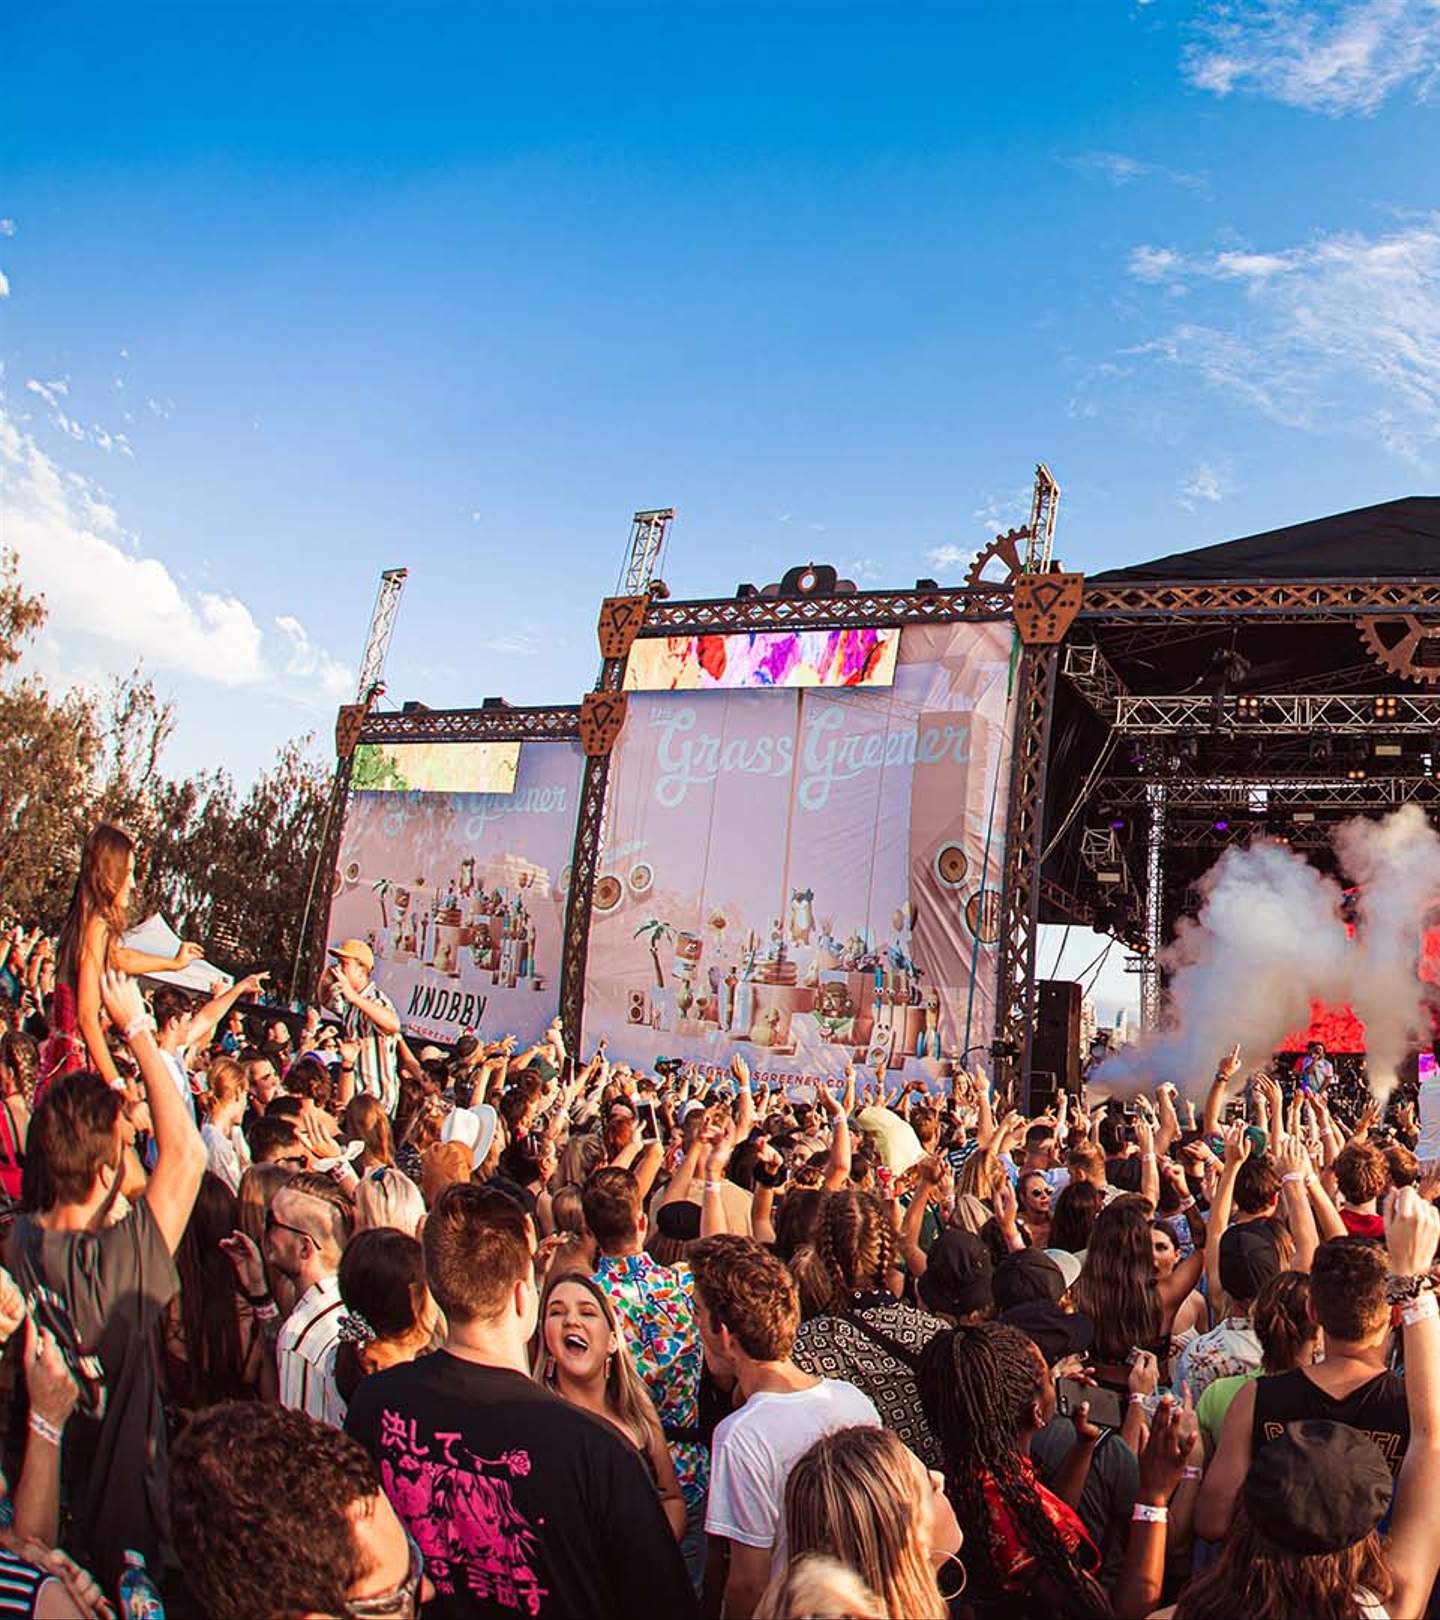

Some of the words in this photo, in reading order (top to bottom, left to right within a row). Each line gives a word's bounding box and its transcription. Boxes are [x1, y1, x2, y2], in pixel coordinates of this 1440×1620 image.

[650, 707, 793, 809] Grass
[799, 706, 971, 811] Greener
[406, 984, 488, 1030] KNOBBY
